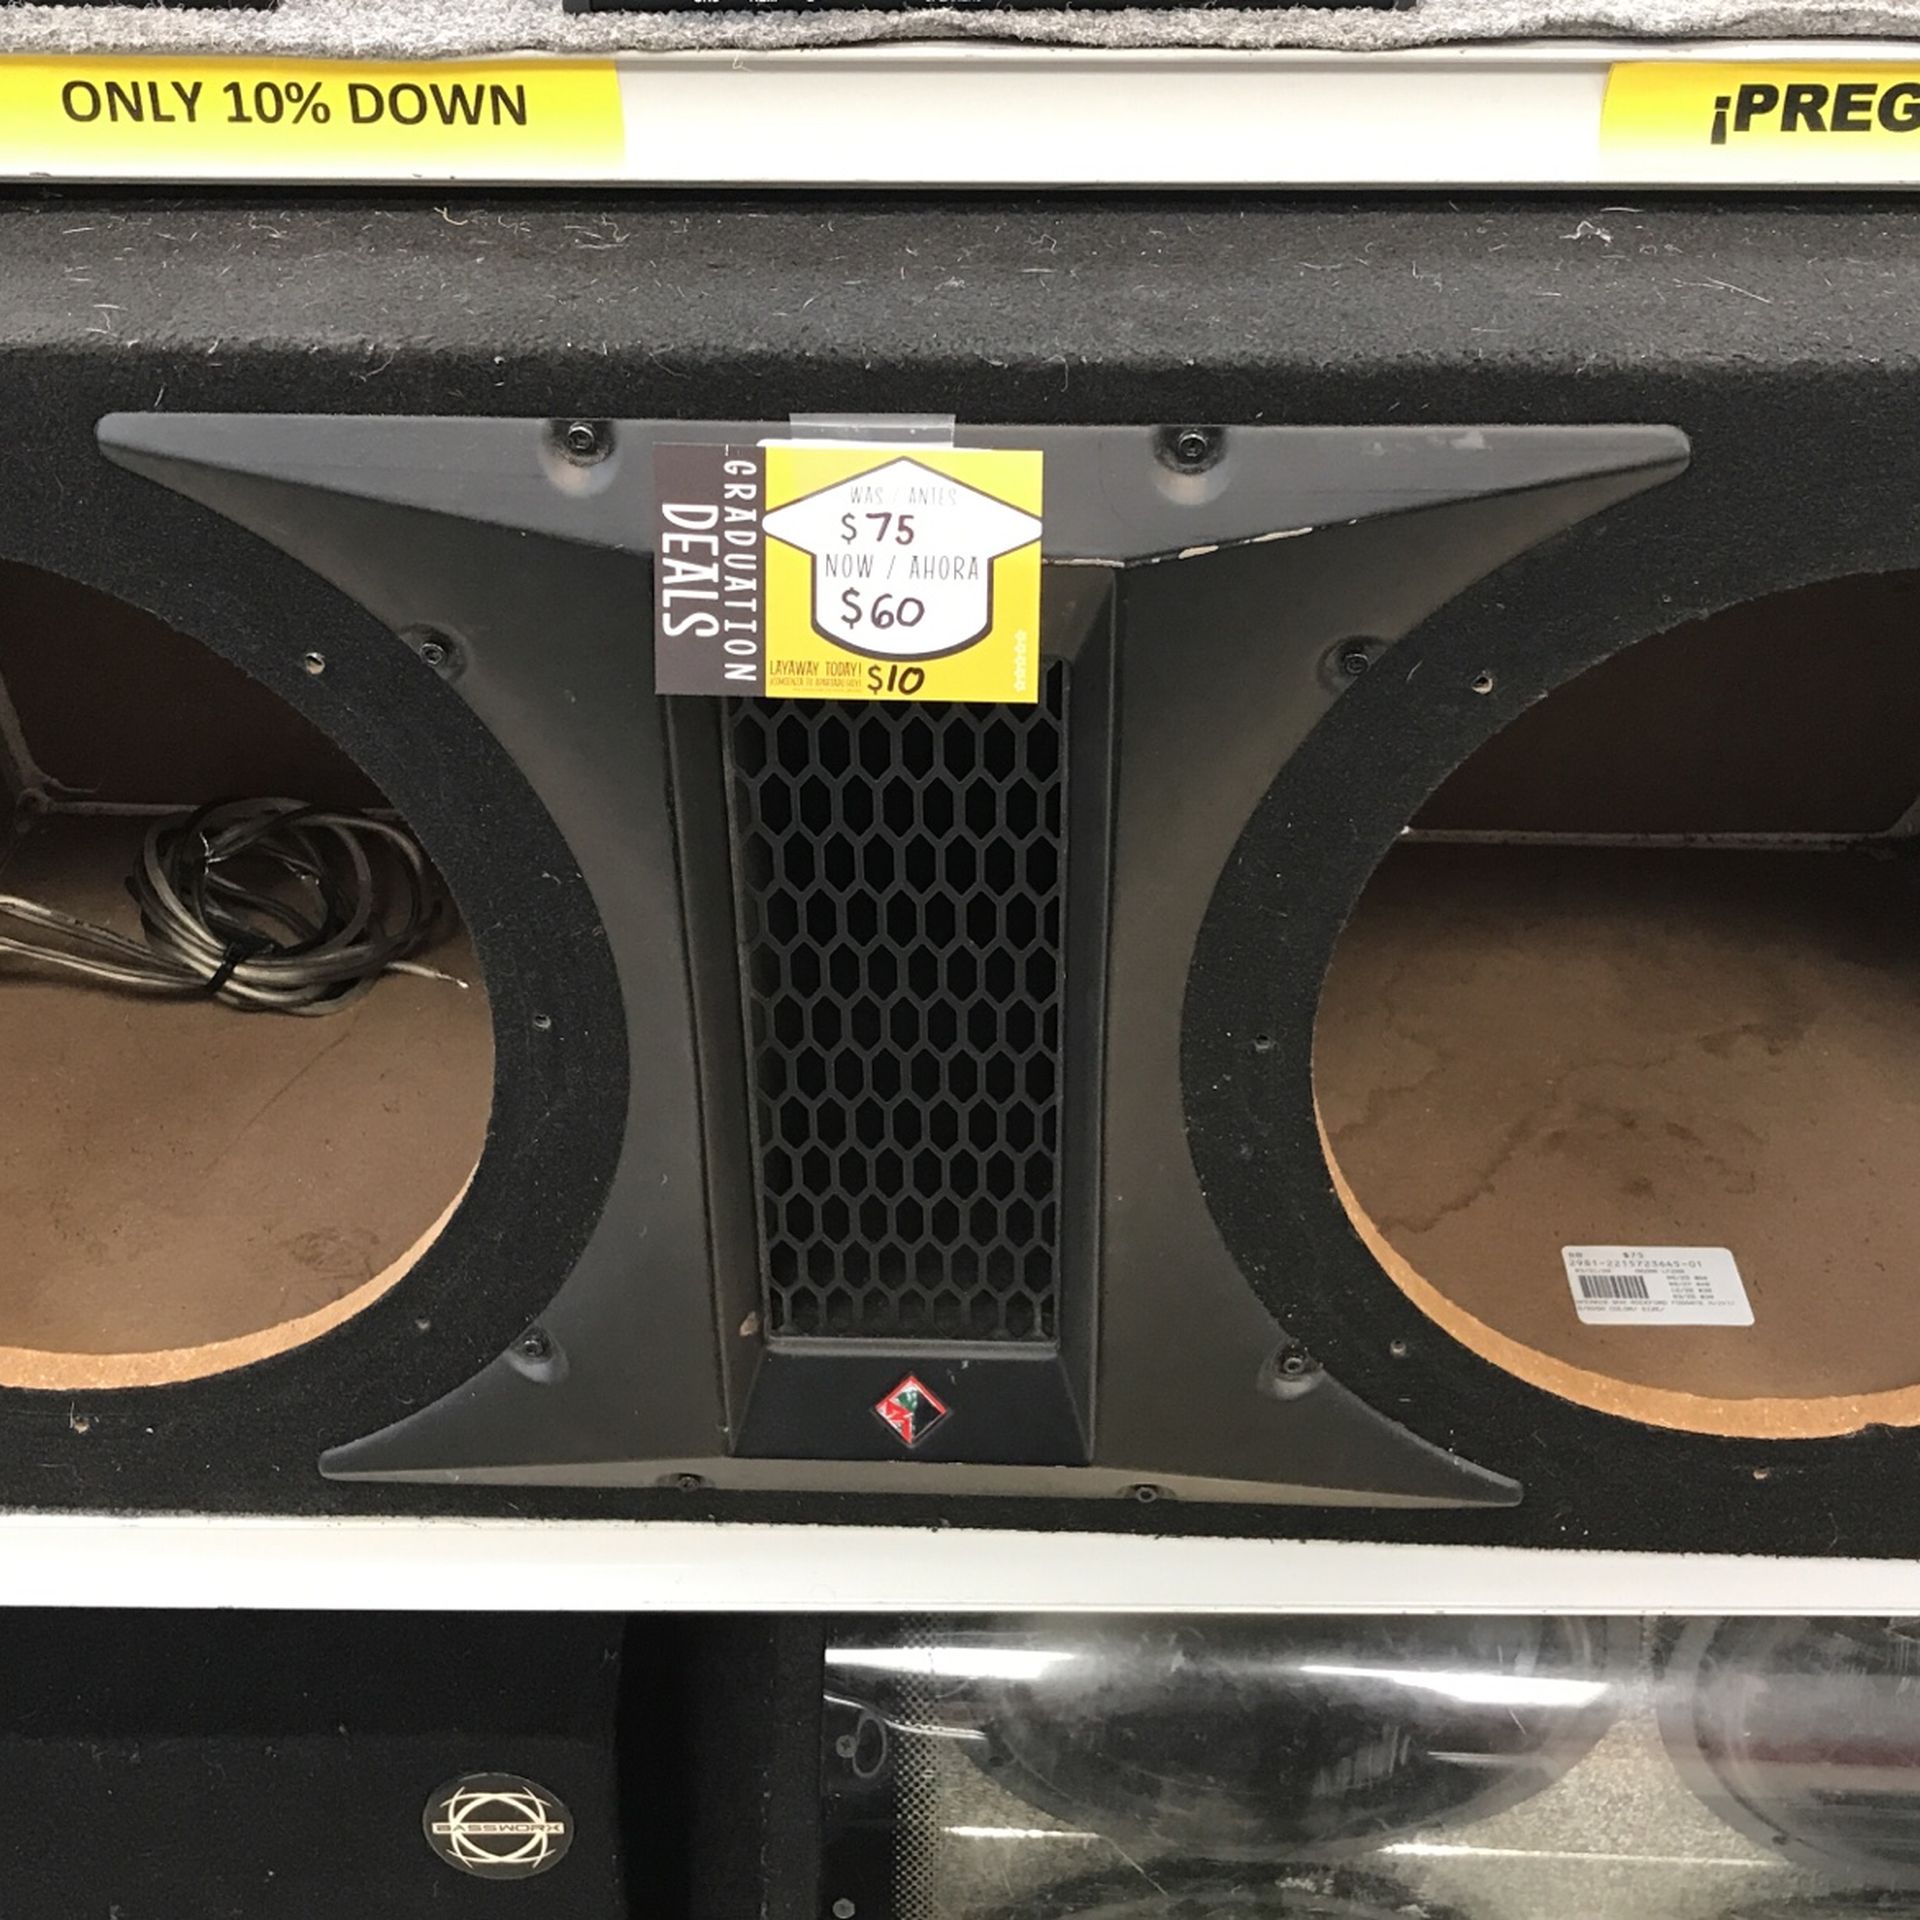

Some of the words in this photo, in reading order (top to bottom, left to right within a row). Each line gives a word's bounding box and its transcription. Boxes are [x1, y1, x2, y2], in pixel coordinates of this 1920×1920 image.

[61, 80, 203, 123] ONLY
[222, 81, 332, 124] 10%
[348, 83, 528, 126] DOWN
[850, 485, 884, 505] WAS
[908, 486, 957, 507] ANTES
[662, 502, 720, 638] DEALS
[723, 459, 758, 682] GRADUATION
[825, 553, 874, 579] NOW
[908, 555, 979, 581] AHORA
[841, 586, 926, 630] $60
[770, 659, 819, 676] LAYAWAY
[825, 661, 862, 677] TODAY!
[867, 664, 926, 696] $10
[436, 1823, 562, 1832] BASSWORX
